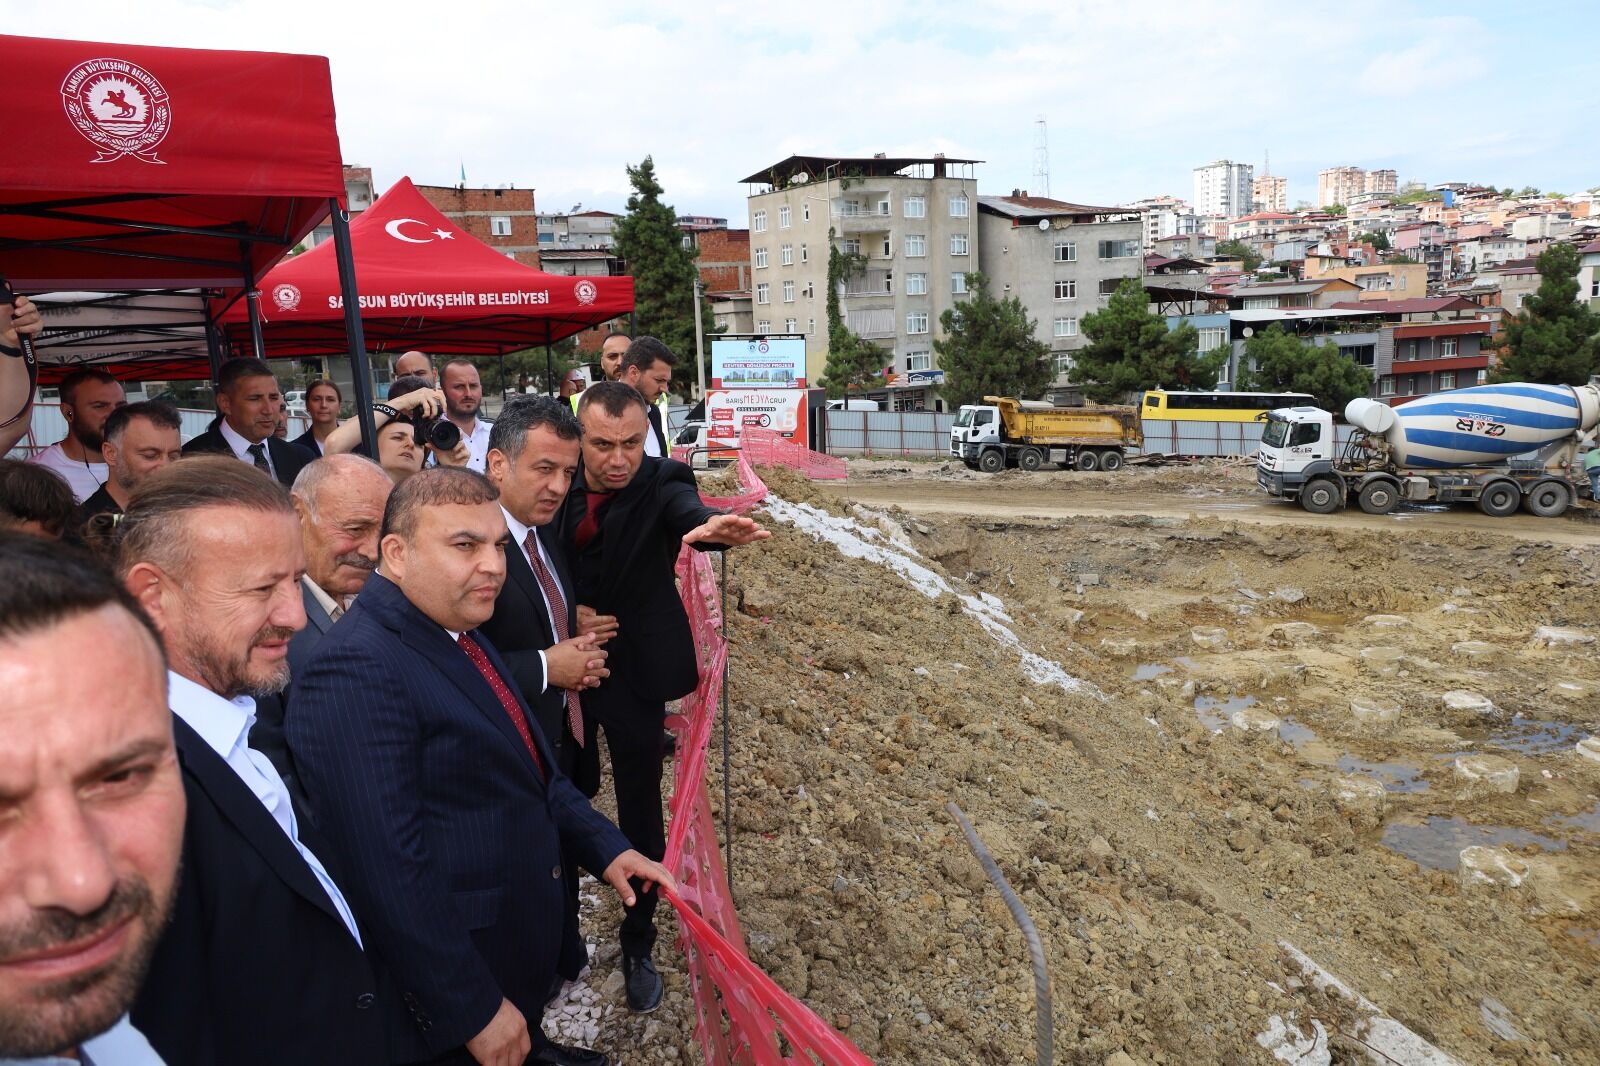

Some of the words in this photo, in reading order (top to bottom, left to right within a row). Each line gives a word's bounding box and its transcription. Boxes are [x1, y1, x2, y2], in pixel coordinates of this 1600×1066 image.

[66, 69, 87, 93] SAMSUN
[131, 68, 163, 97] BELEDİYESİ
[328, 295, 386, 309] SASUN
[390, 291, 475, 309] BÜYÜKŞEHİR
[479, 290, 549, 305] BELEDİYESİ
[24, 339, 35, 364] Canon
